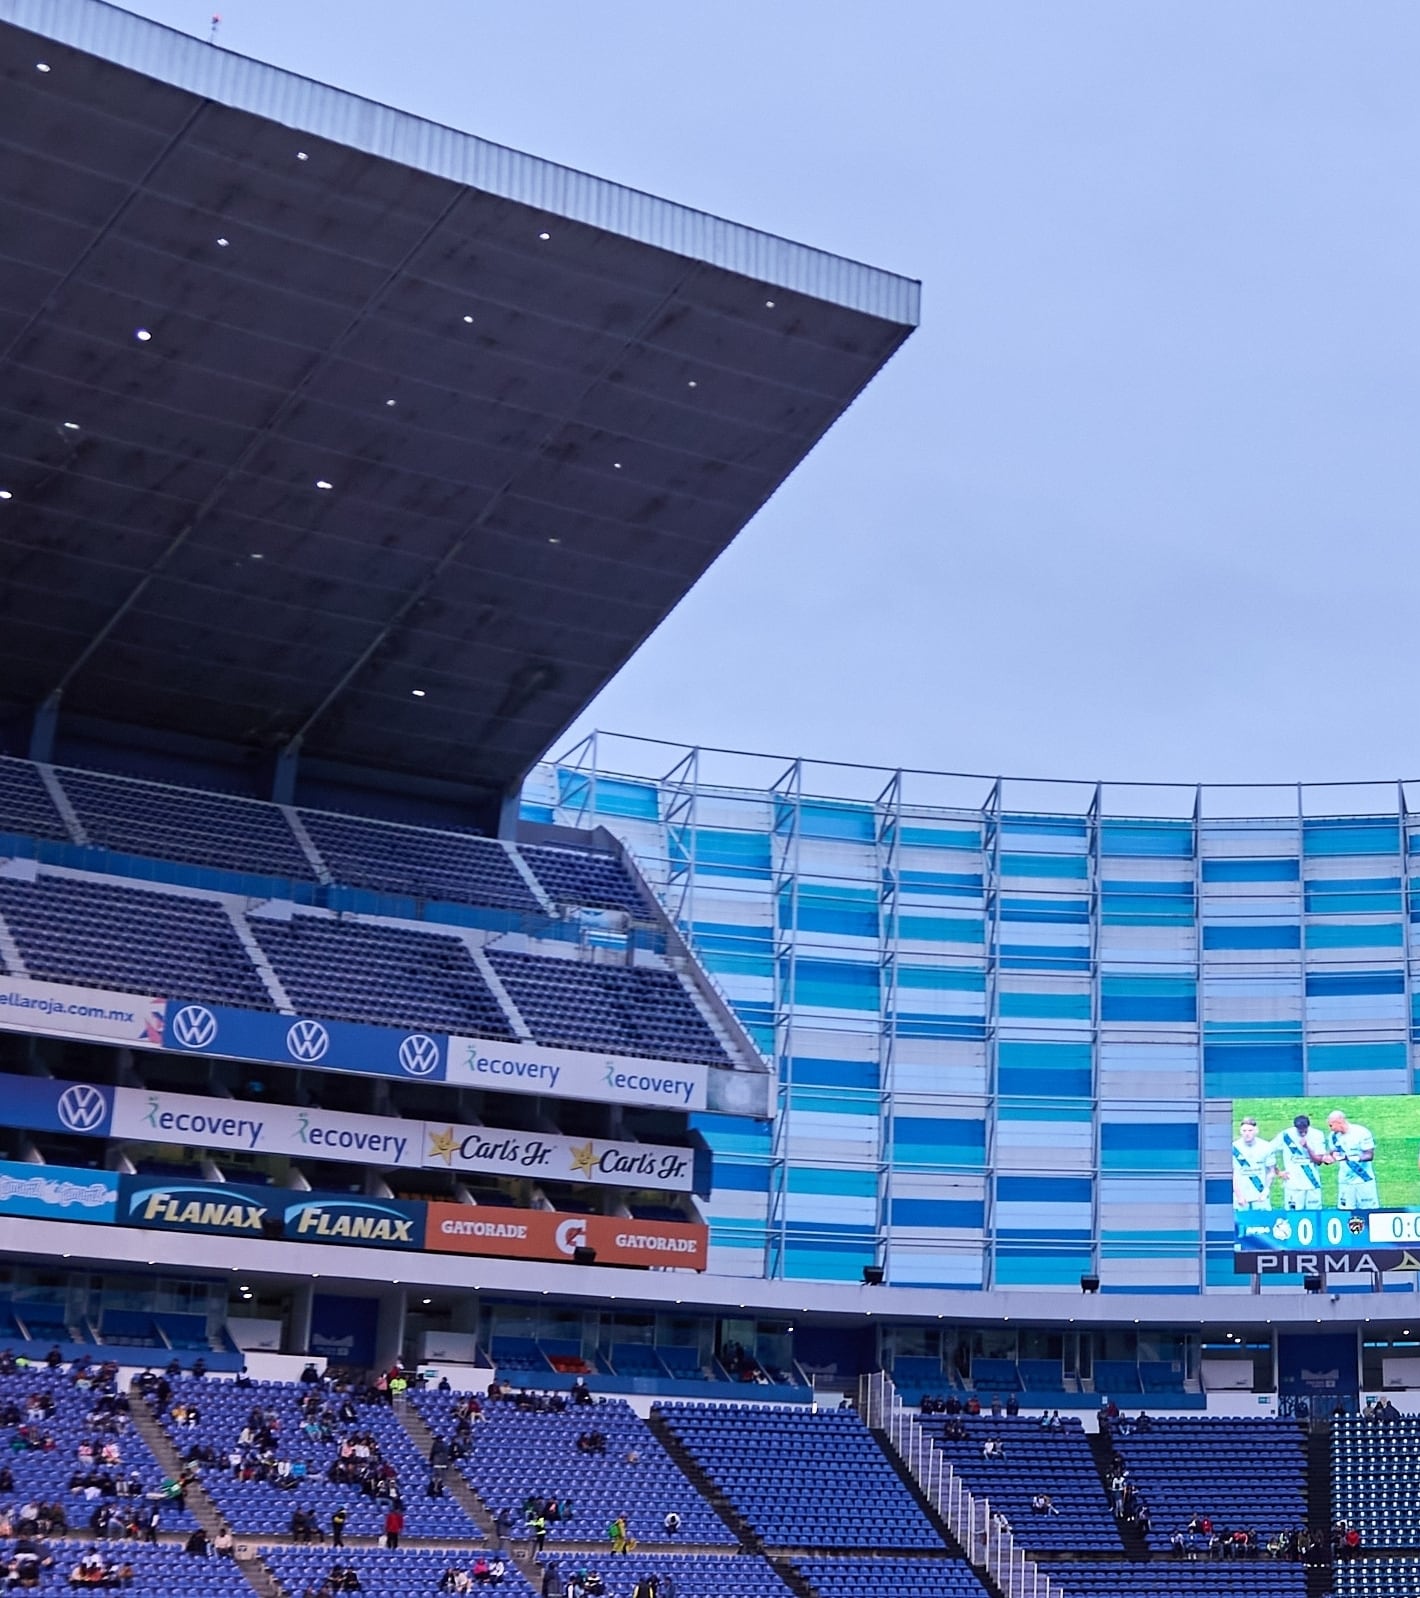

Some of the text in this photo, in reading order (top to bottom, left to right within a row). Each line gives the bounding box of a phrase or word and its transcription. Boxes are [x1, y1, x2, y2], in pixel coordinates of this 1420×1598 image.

[144, 1193, 268, 1230] FLANAX
[298, 1207, 414, 1241] FLANAX
[441, 1220, 527, 1239] GATORADE
[615, 1234, 697, 1253] GATORADE
[1298, 1218, 1313, 1246] 0
[1327, 1217, 1343, 1245] 0
[1257, 1254, 1379, 1275] PIRMA
